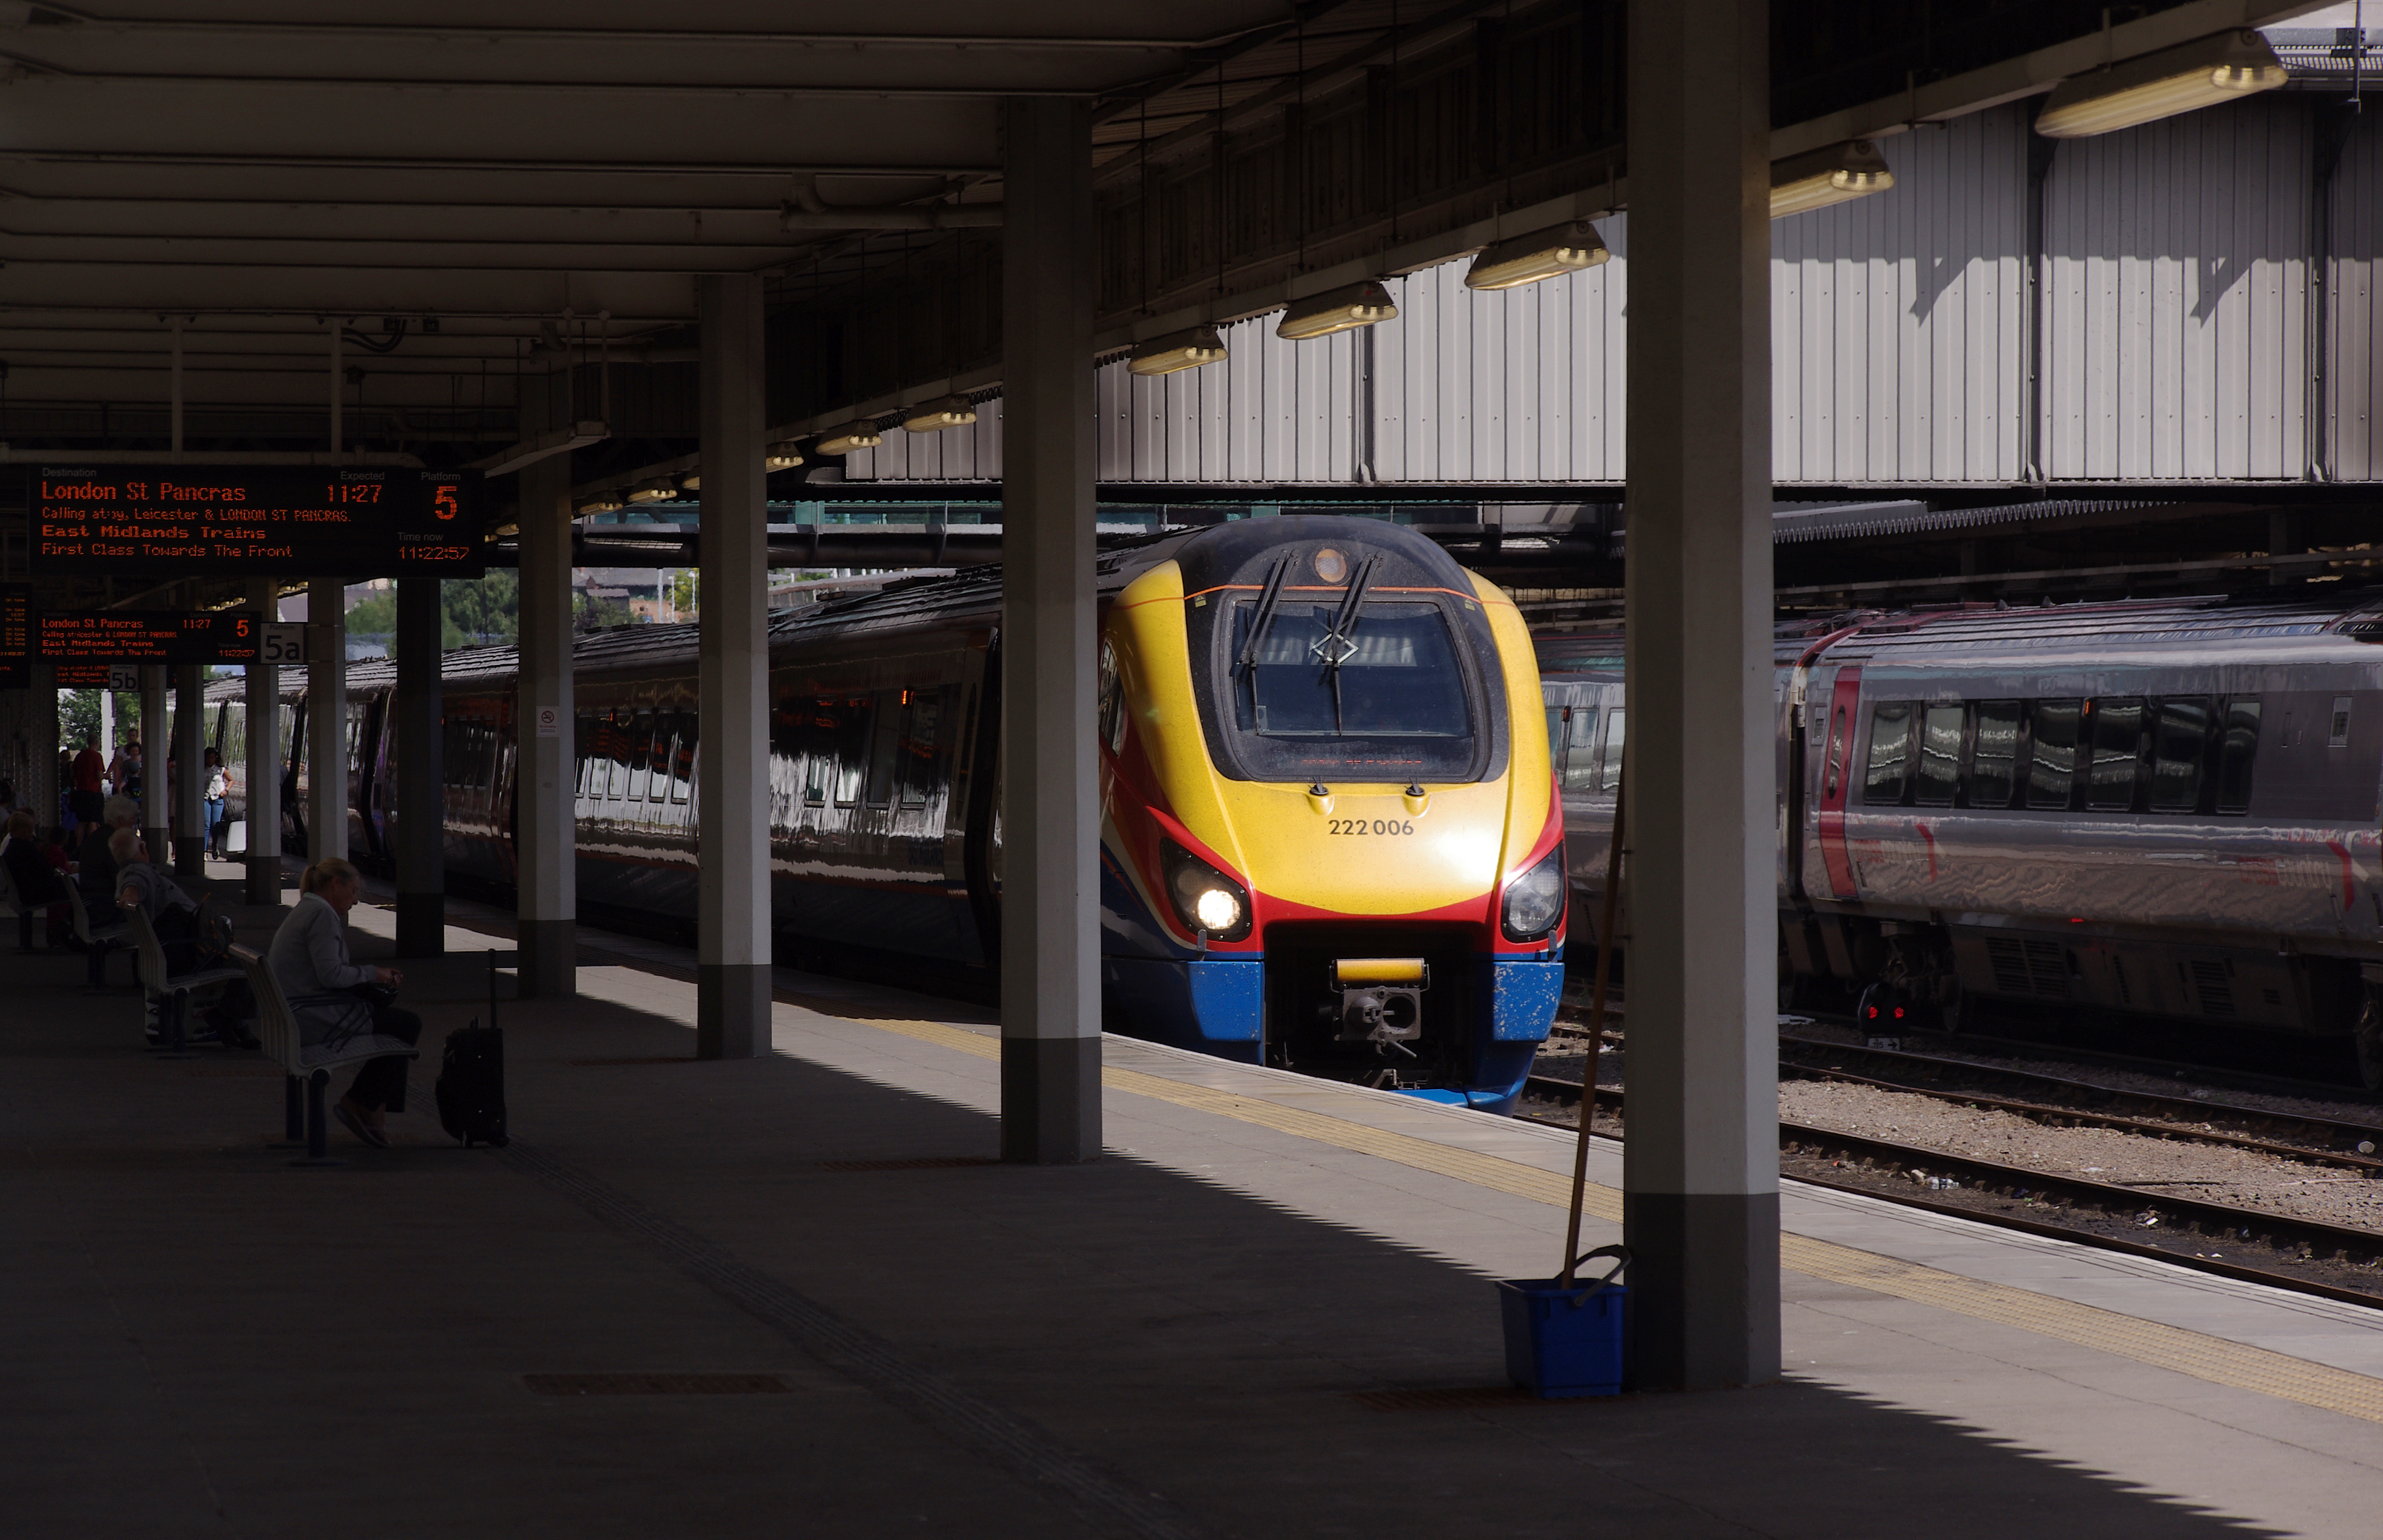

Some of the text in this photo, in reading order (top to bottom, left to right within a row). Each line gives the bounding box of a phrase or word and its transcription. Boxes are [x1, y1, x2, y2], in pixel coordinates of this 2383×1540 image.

[42, 468, 97, 477] Destination
[340, 471, 385, 481] Expected
[421, 472, 461, 481] Platform
[42, 481, 246, 501] London St Pancras
[328, 484, 382, 503] 11:27
[435, 485, 458, 520] 5
[42, 506, 86, 521] Calling
[134, 508, 199, 520] Leicester
[205, 508, 215, 521] &
[219, 509, 266, 521] LONDON
[271, 509, 288, 521] ST
[293, 510, 352, 522] PANCRAS.
[42, 525, 266, 540] East Midlands Trains
[398, 532, 421, 541] Time
[42, 542, 293, 557] First Class Towards The Front
[399, 546, 470, 560] 11:22:57
[42, 619, 144, 629] London St Pancras
[183, 619, 211, 629] 11:27
[236, 619, 249, 637] 5
[218, 649, 256, 657] 11:22:57
[266, 635, 300, 661] 5a
[112, 673, 137, 689] 5b
[1328, 819, 1415, 836] 222 006
